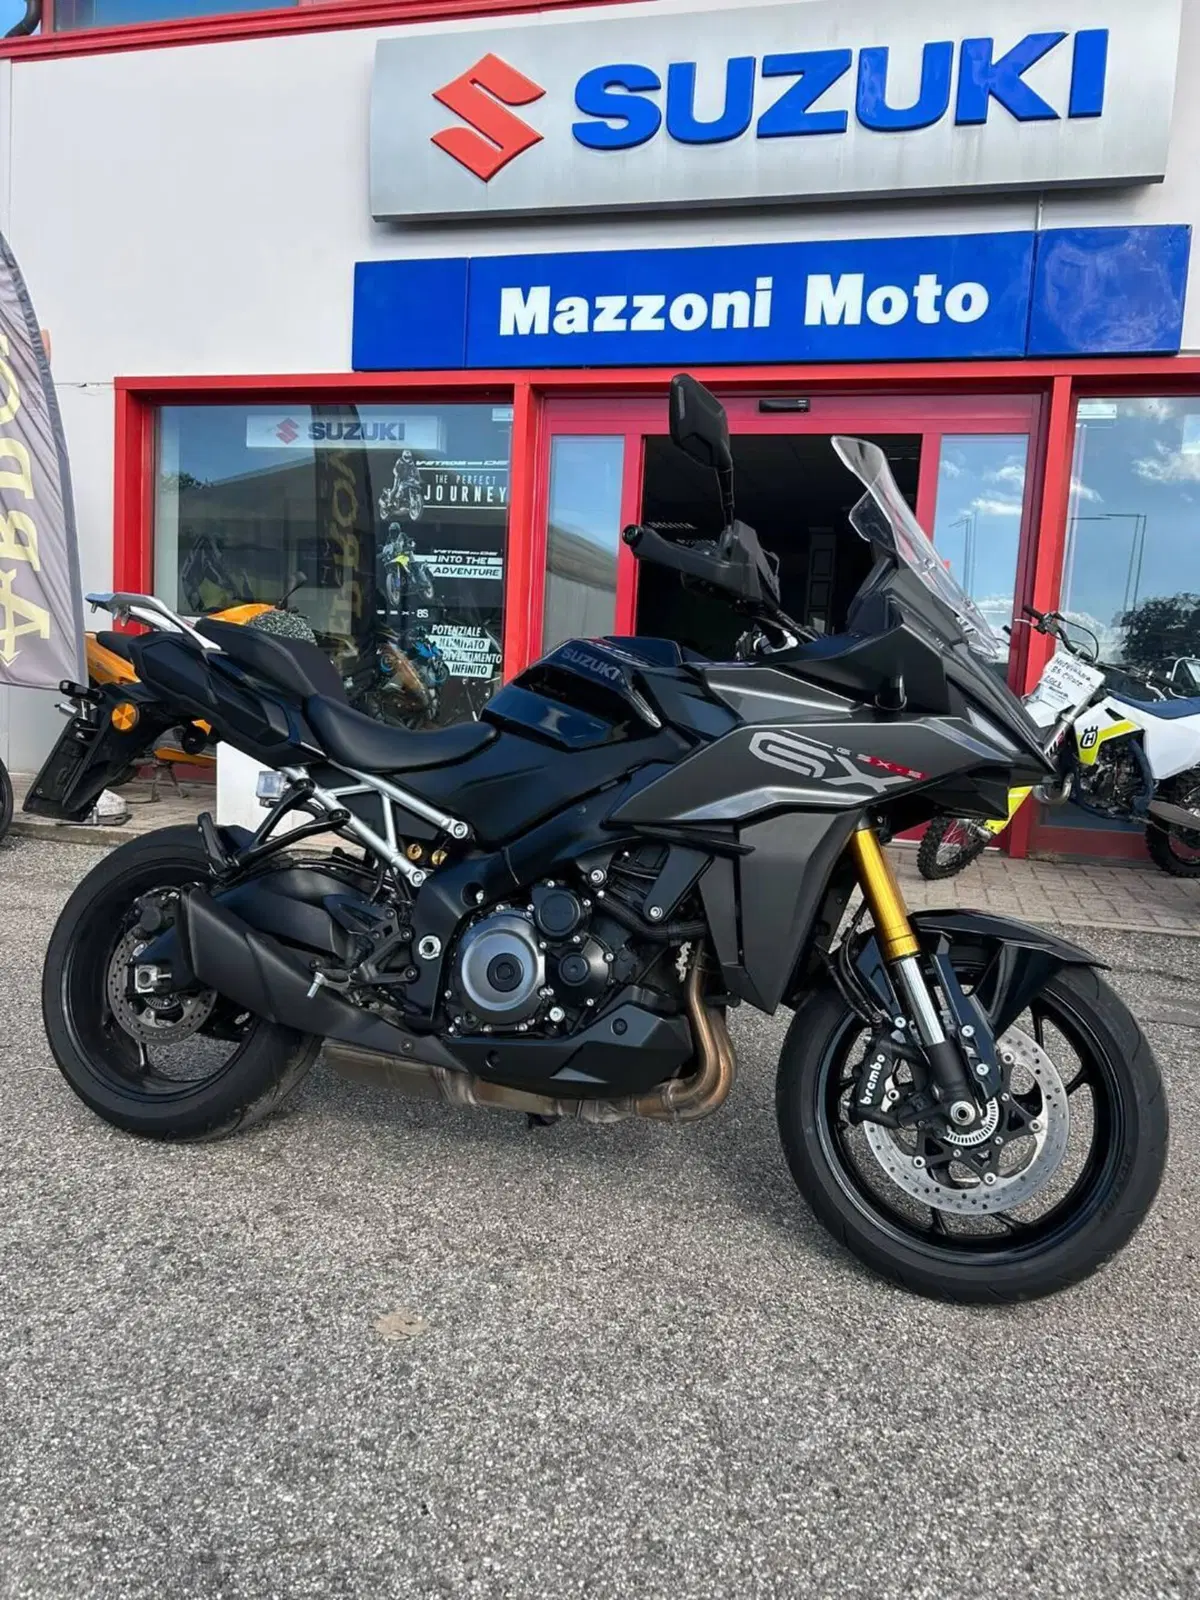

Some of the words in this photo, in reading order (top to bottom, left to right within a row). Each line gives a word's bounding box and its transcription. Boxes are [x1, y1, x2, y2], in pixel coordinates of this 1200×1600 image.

[571, 28, 1109, 151] SUZUKI
[500, 276, 773, 336] Mazzoni
[804, 273, 990, 327] Moto
[308, 420, 406, 441] SUZUKI
[435, 474, 449, 484] THE
[456, 475, 496, 486] PERFECT
[423, 484, 508, 504] JOURNEY
[437, 555, 463, 564] INTO
[465, 556, 488, 565] THE
[433, 566, 501, 577] ADVENTURE
[431, 624, 482, 637] POTENZIALE
[451, 664, 488, 675] INFINITO
[561, 648, 622, 681] SUZUKI
[860, 1054, 886, 1105] brembo
